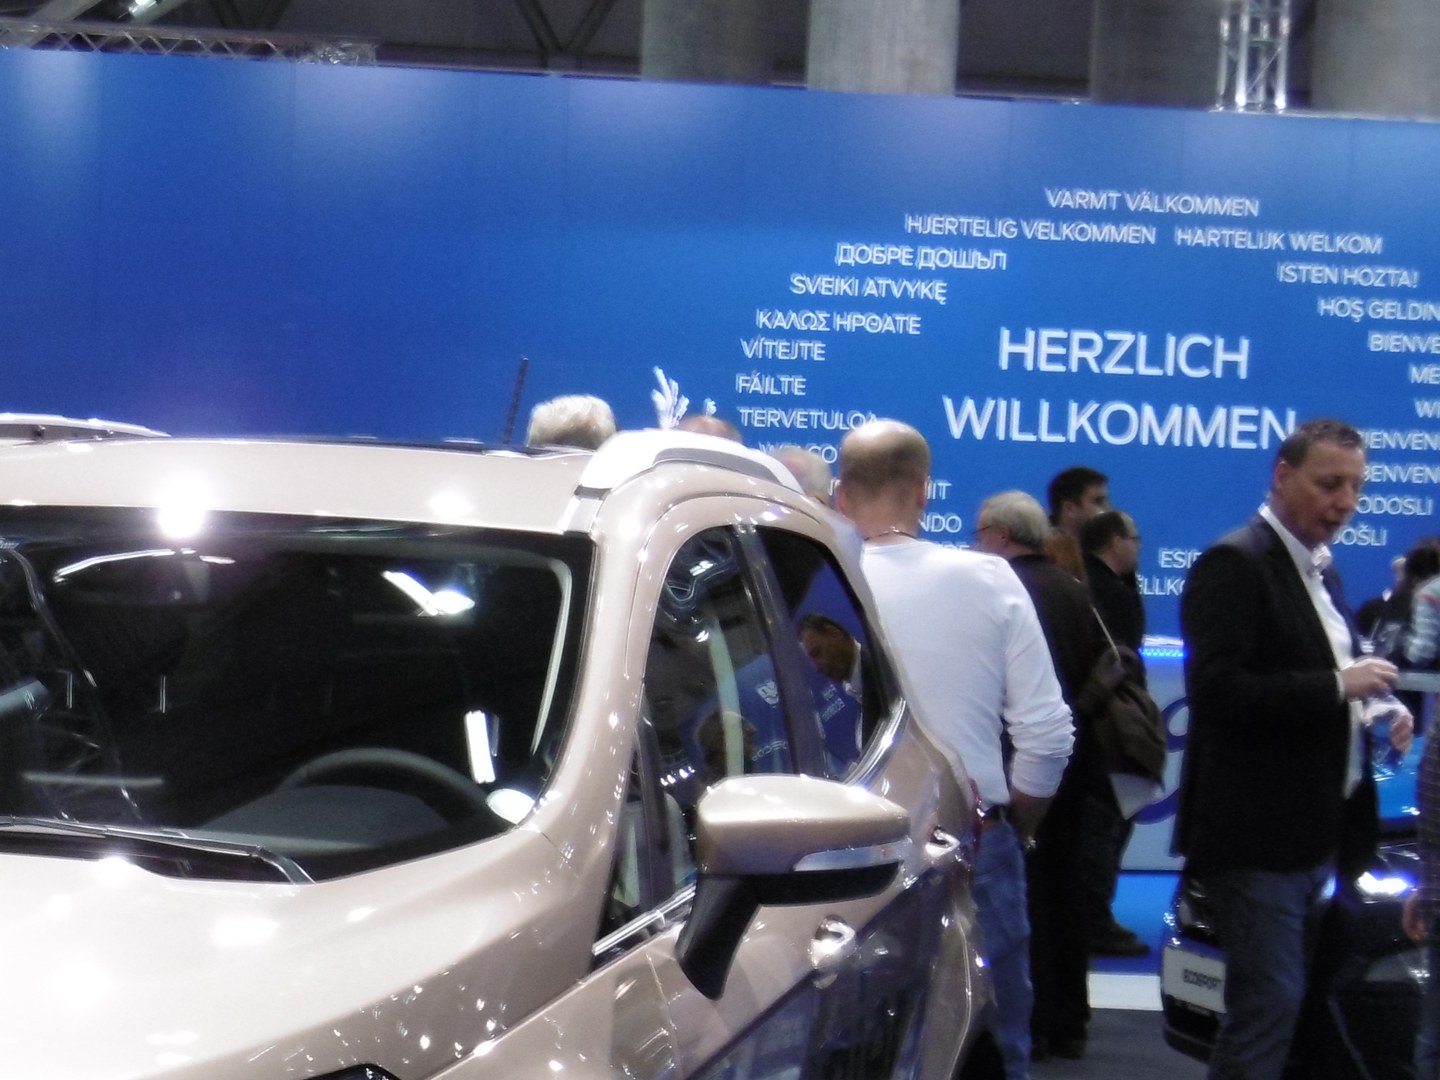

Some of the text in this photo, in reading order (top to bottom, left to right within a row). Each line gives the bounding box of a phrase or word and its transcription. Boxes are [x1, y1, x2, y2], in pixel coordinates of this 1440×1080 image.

[1044, 187, 1258, 217] VARMT VÄLKOMMEN
[905, 213, 1156, 245] HJERTELIG VELKOMMEN
[1175, 226, 1383, 255] HARTELIJK WELKOM
[835, 242, 914, 267] ДОБРЕ
[789, 272, 859, 297] SVEIKI
[1277, 262, 1418, 289] ISTEN HOZTA!
[739, 334, 826, 361] VÍTEJTE
[998, 325, 1250, 381] HERZLICH
[735, 368, 807, 396] FÁILTE
[943, 394, 1296, 450] WILLKOMMEN
